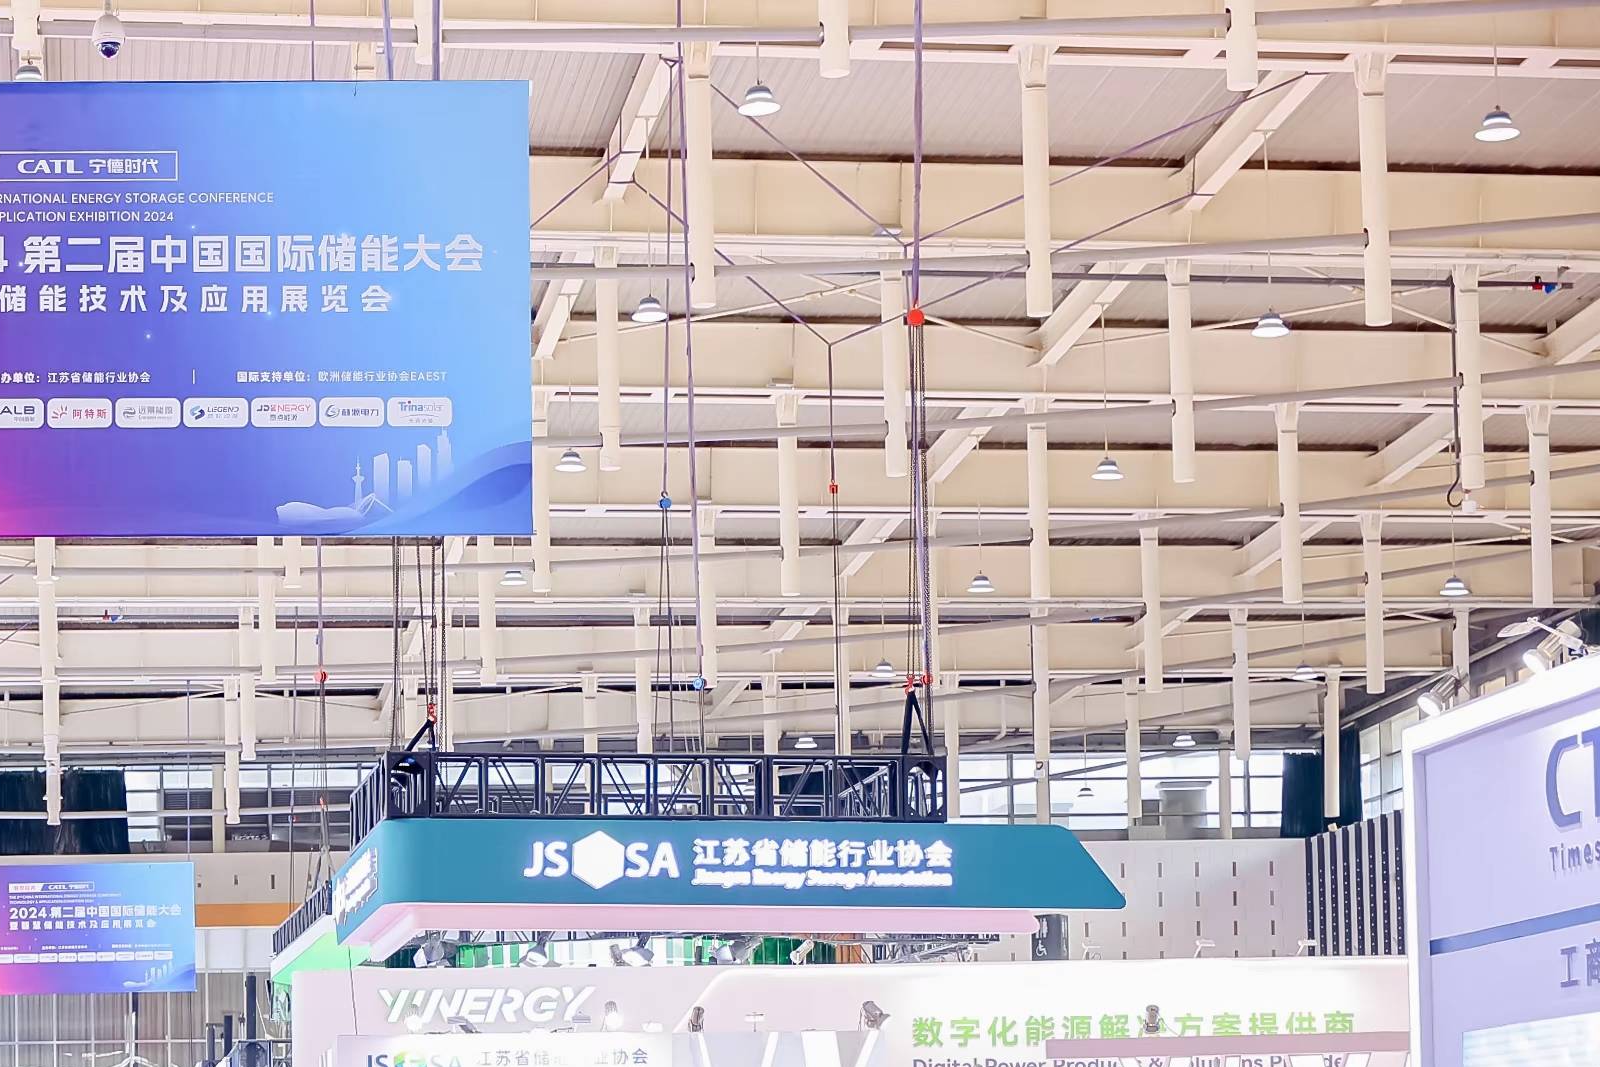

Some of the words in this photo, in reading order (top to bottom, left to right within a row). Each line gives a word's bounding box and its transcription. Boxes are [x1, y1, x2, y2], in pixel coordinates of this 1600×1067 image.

[17, 159, 83, 175] CATL
[88, 158, 159, 175] 宁德时代
[71, 193, 121, 204] ENERGY
[124, 192, 185, 204] STORAGE
[188, 192, 274, 204] CONFERENCE
[69, 211, 140, 222] EXHIBITION
[143, 211, 174, 222] 2024
[72, 408, 107, 420] 阿特斯
[692, 838, 953, 868] 江苏省储能行业协会
